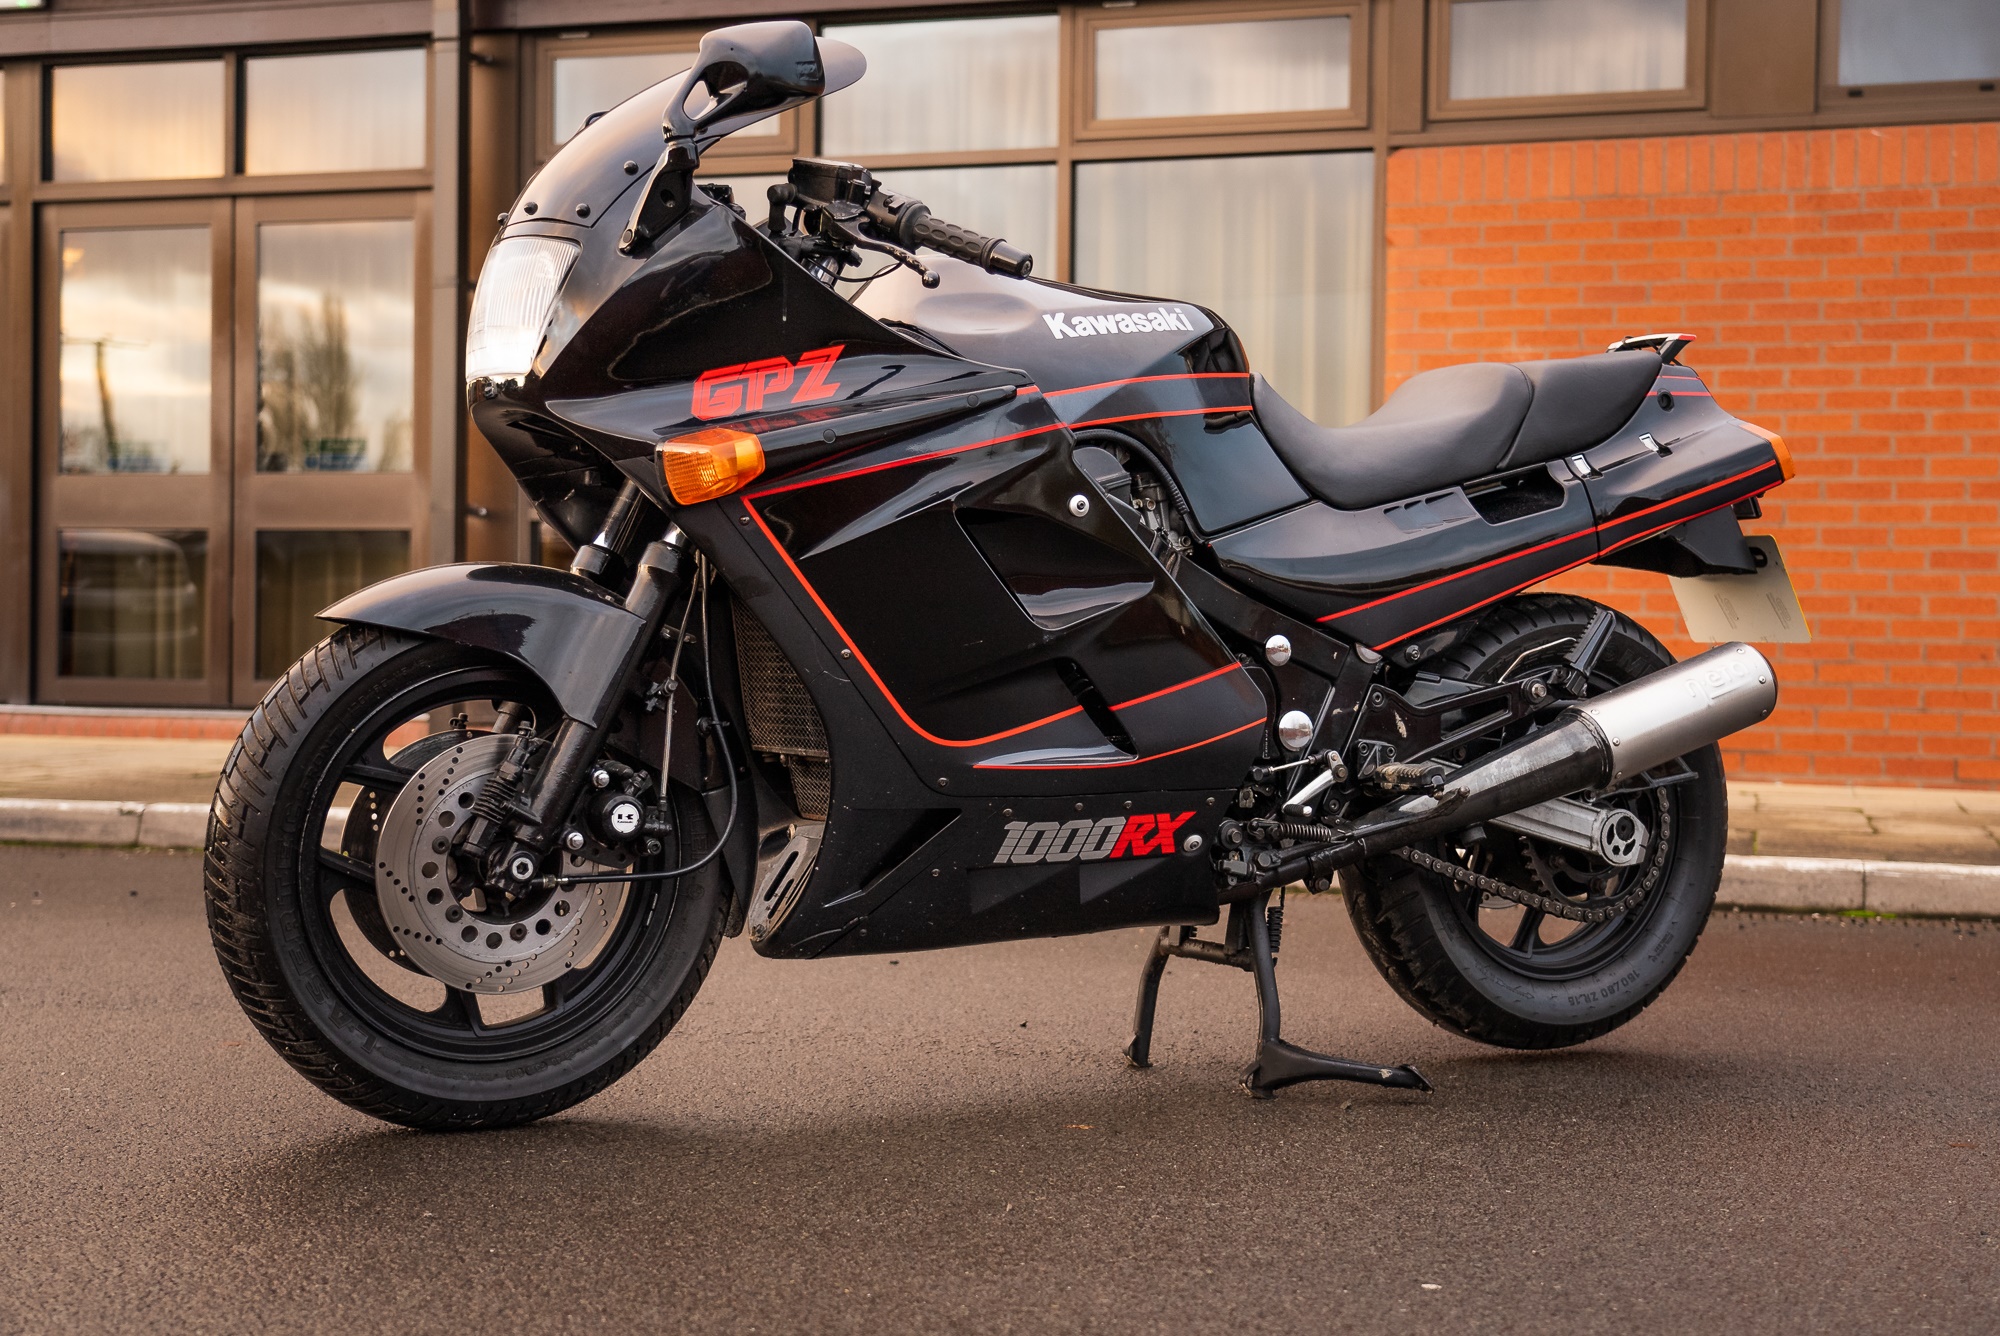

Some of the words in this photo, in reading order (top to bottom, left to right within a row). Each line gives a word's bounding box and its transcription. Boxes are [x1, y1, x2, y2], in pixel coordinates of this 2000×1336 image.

[1043, 307, 1194, 340] Kawasaki
[691, 344, 846, 421] GPZ
[993, 811, 1197, 864] 1000RX
